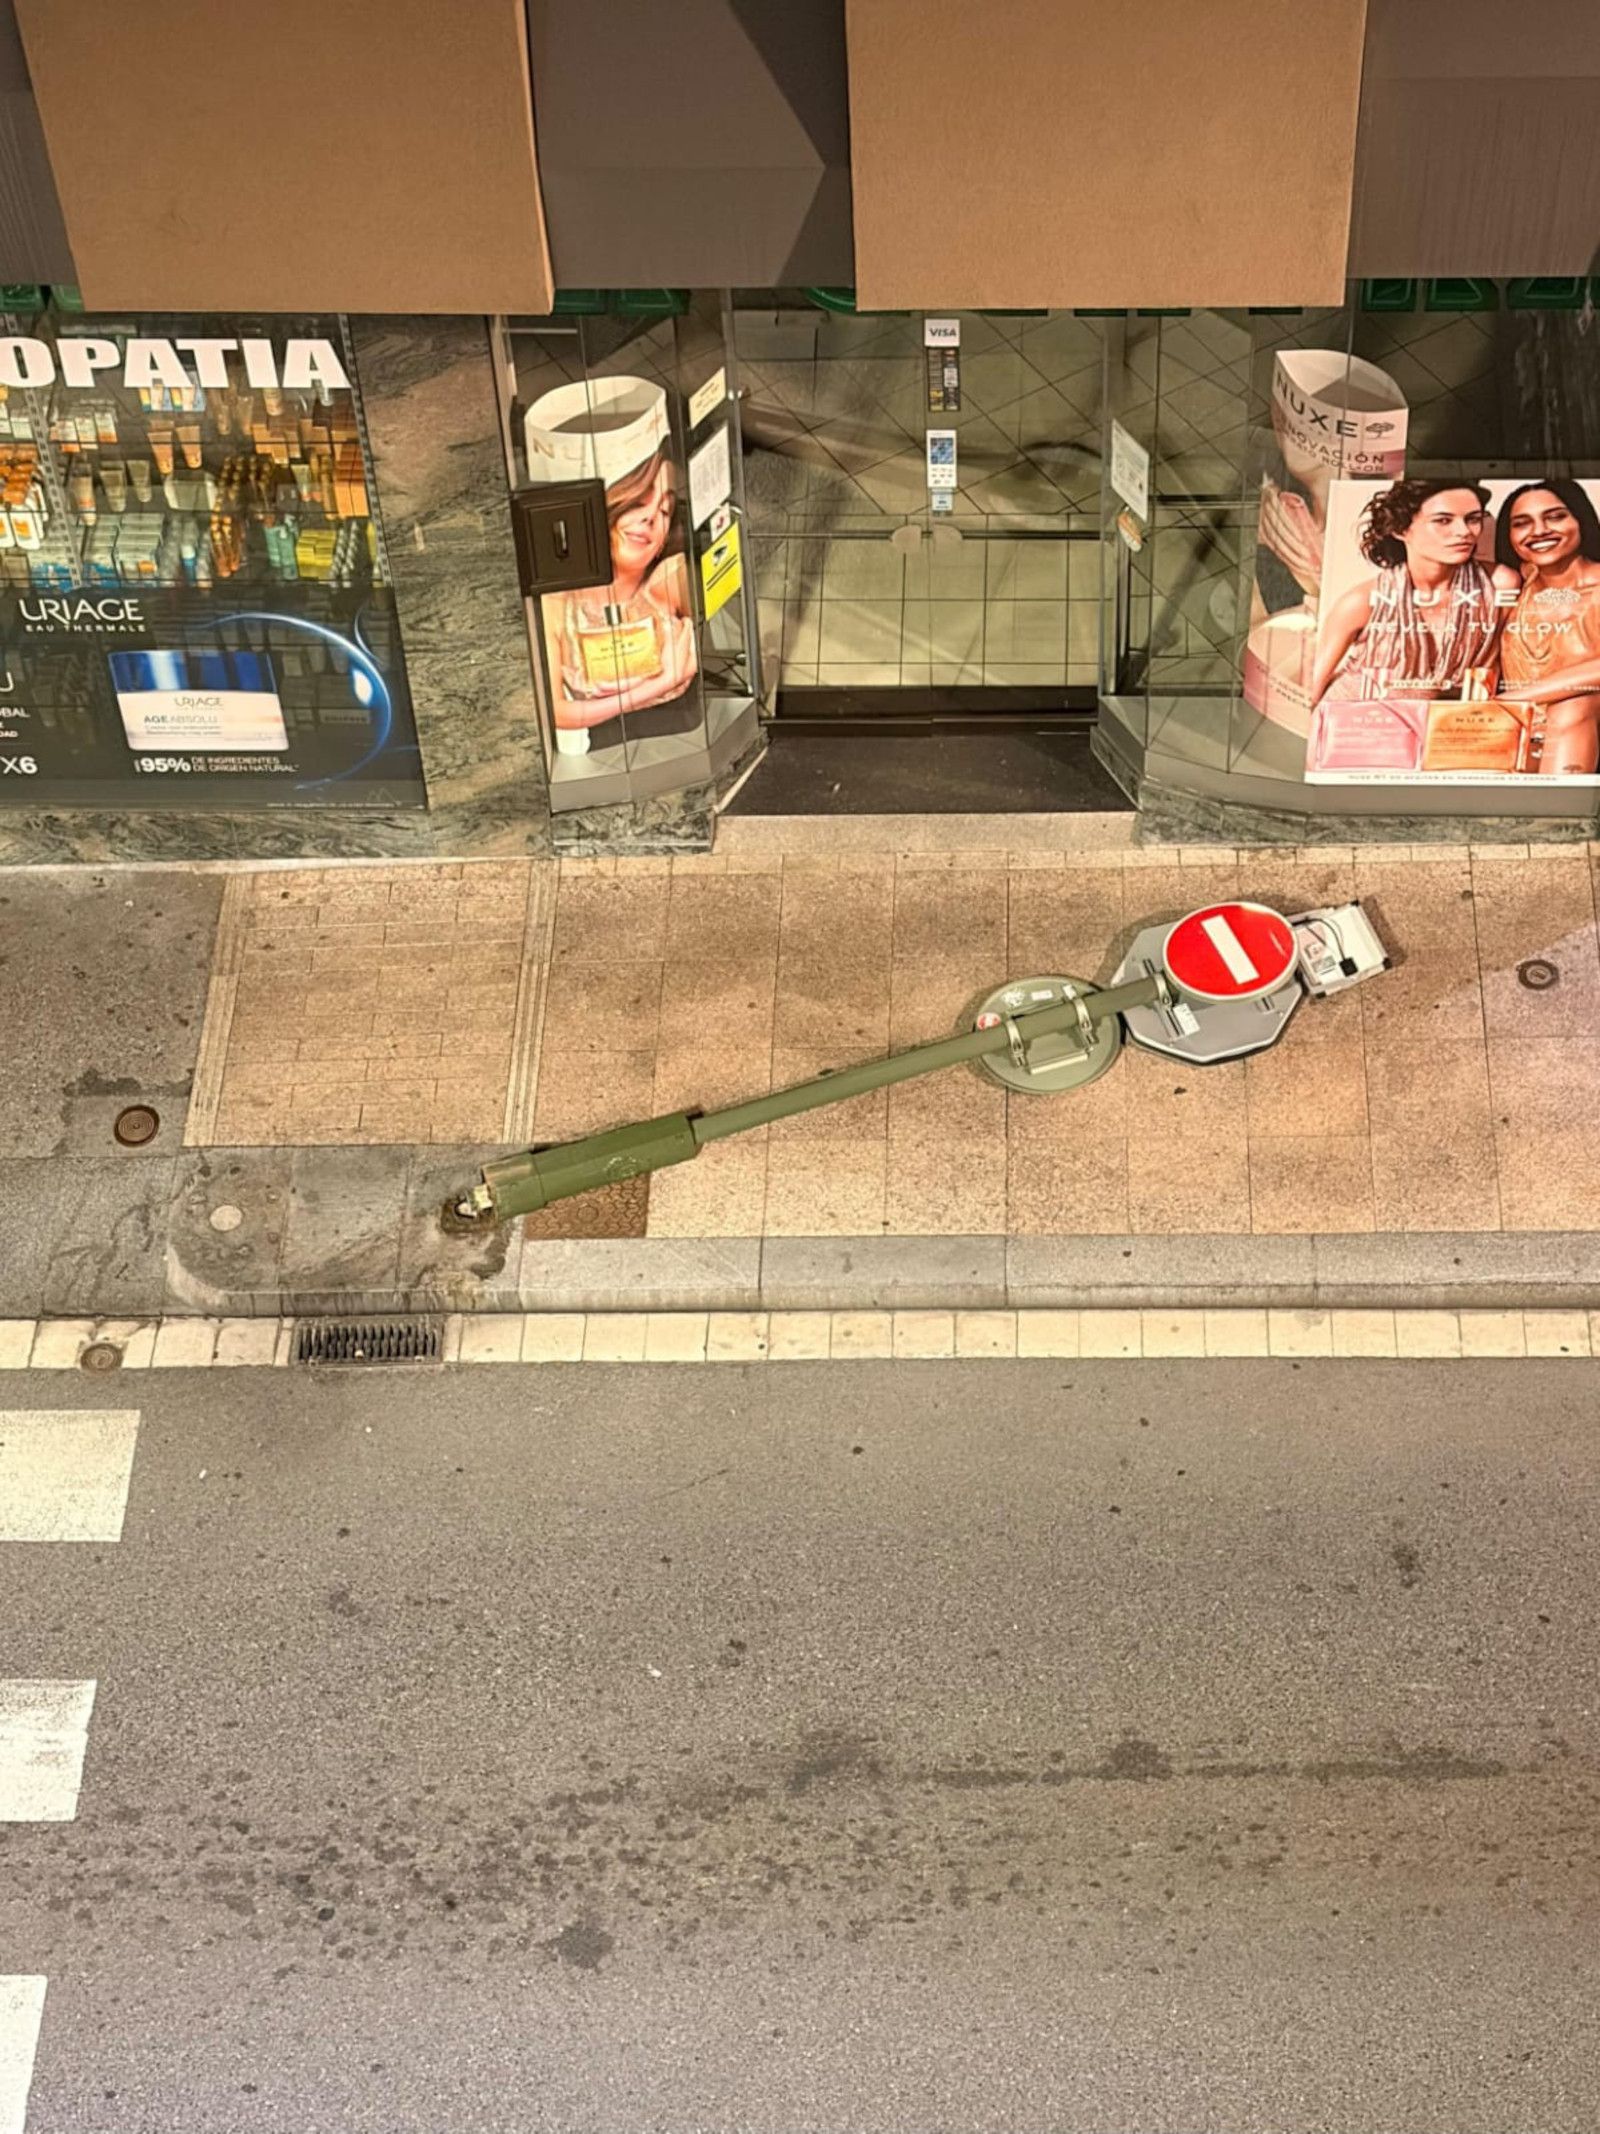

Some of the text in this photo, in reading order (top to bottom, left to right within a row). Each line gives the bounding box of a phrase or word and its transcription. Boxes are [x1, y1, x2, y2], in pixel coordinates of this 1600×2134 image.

[929, 328, 957, 337] VISA
[0, 337, 352, 388] OPATIA
[1276, 372, 1358, 438] NUXE
[1369, 588, 1521, 607] NUXE
[18, 598, 145, 625] URIAGE
[25, 624, 147, 632] EAU THERMALE
[1368, 622, 1573, 634] REVELA TU GLOW
[173, 697, 223, 708] URIAGE
[0, 706, 31, 718] BAL
